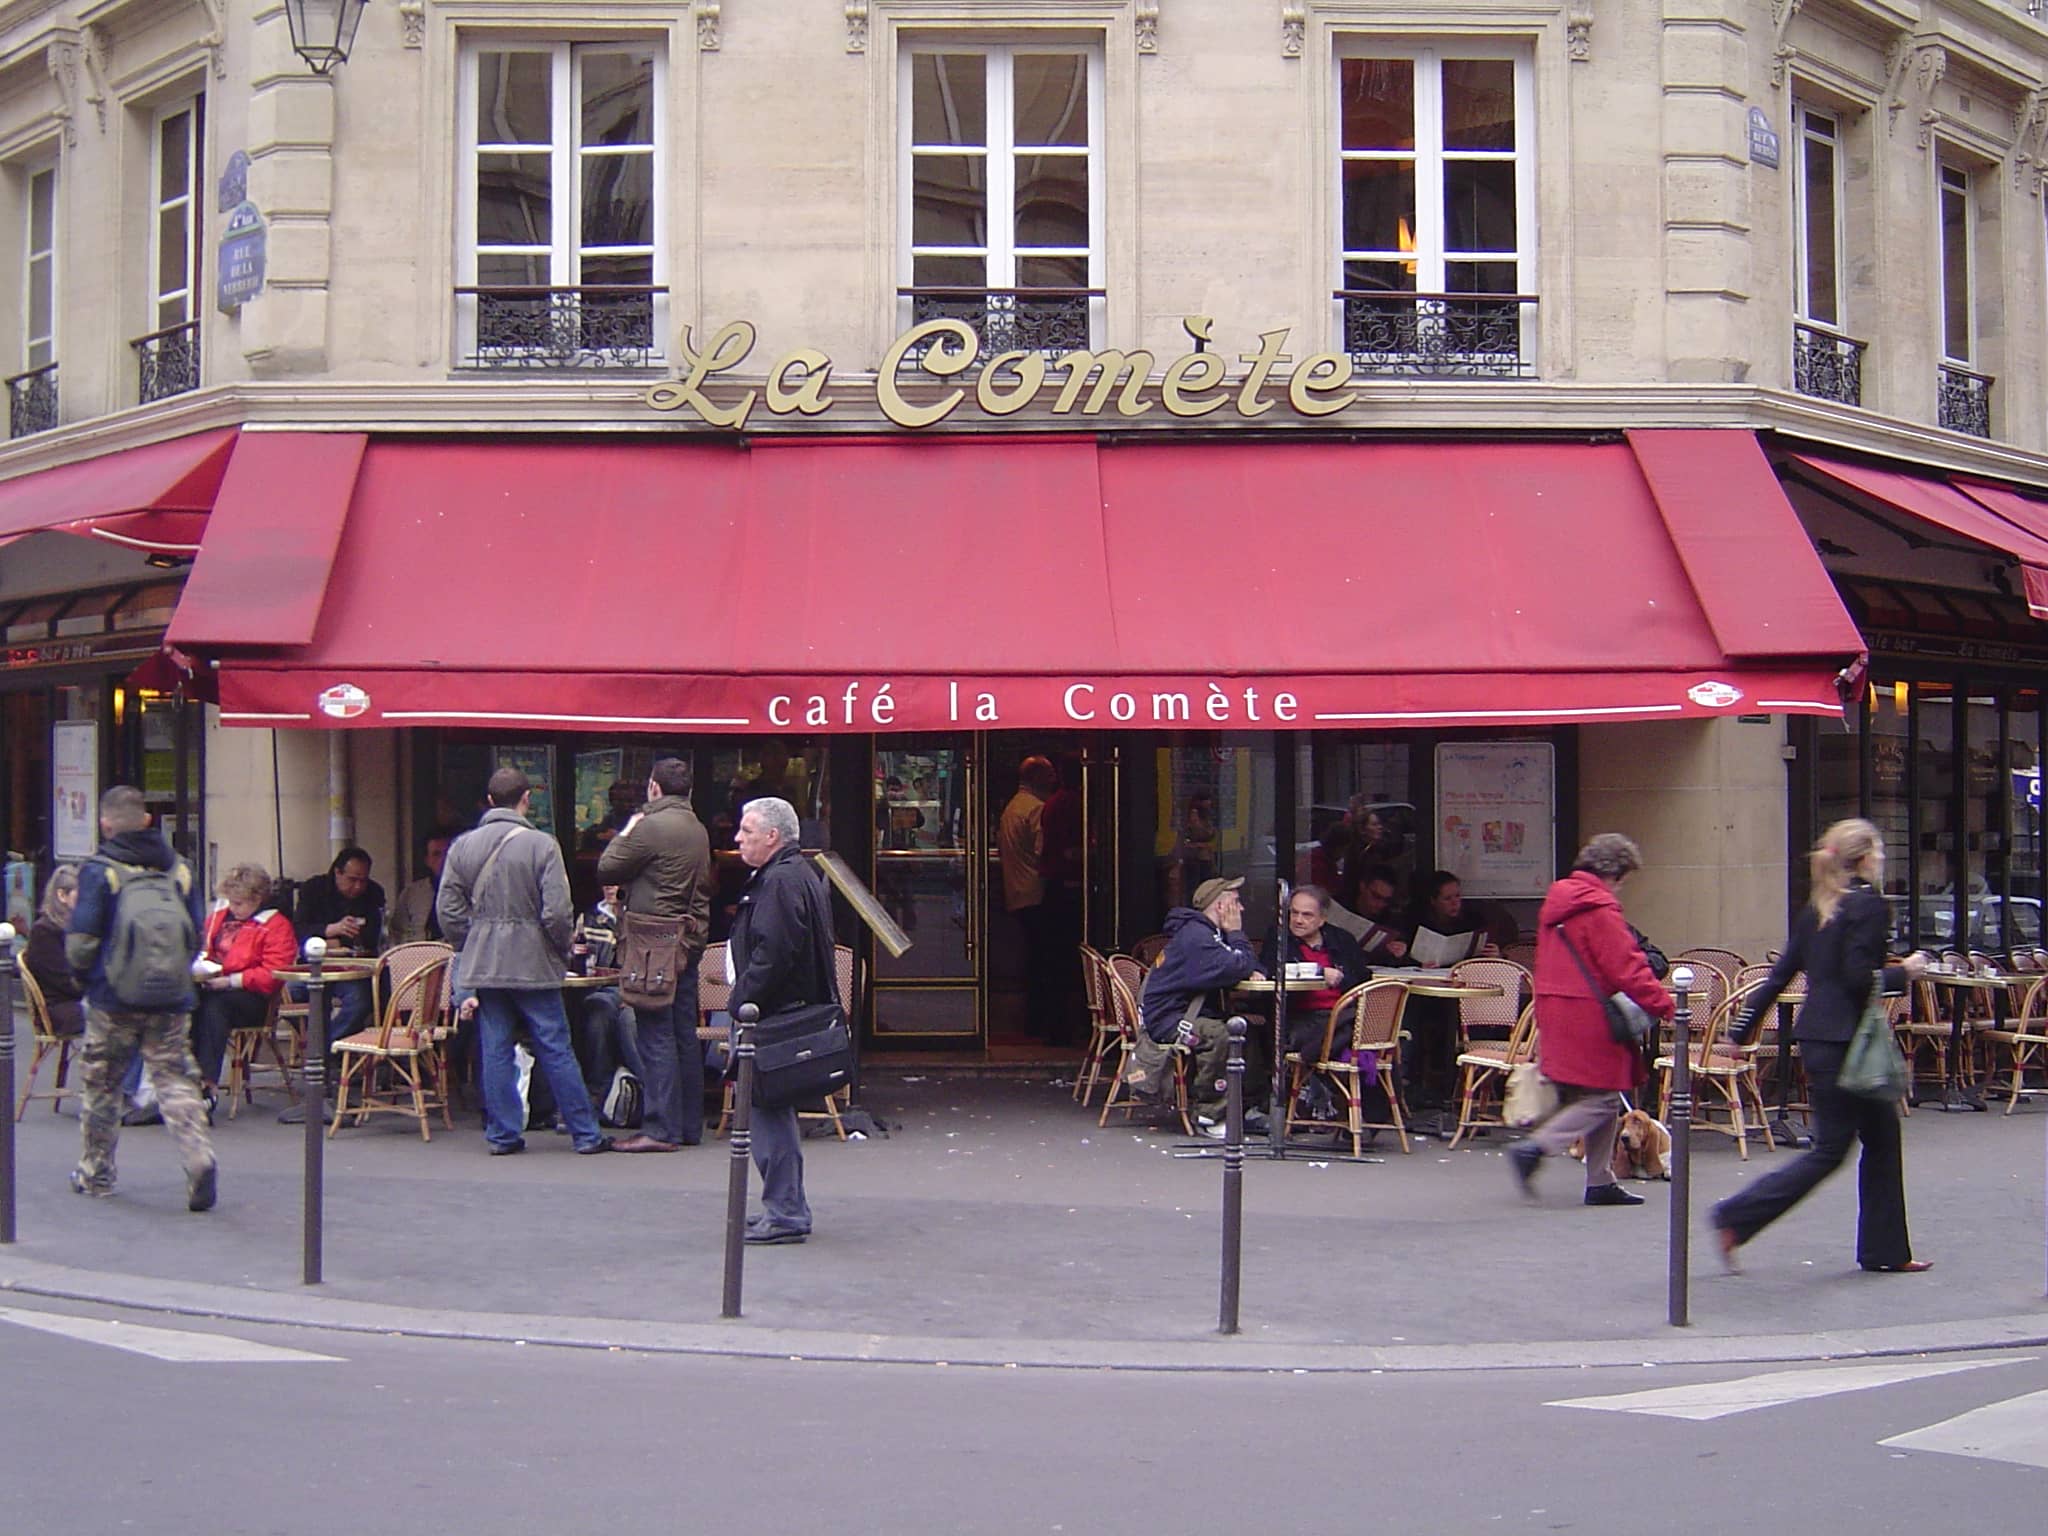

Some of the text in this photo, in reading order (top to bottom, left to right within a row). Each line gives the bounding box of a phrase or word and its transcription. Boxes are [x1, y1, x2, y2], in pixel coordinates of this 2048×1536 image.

[645, 316, 1359, 430] La Comète
[768, 682, 1298, 725] café la Comète
